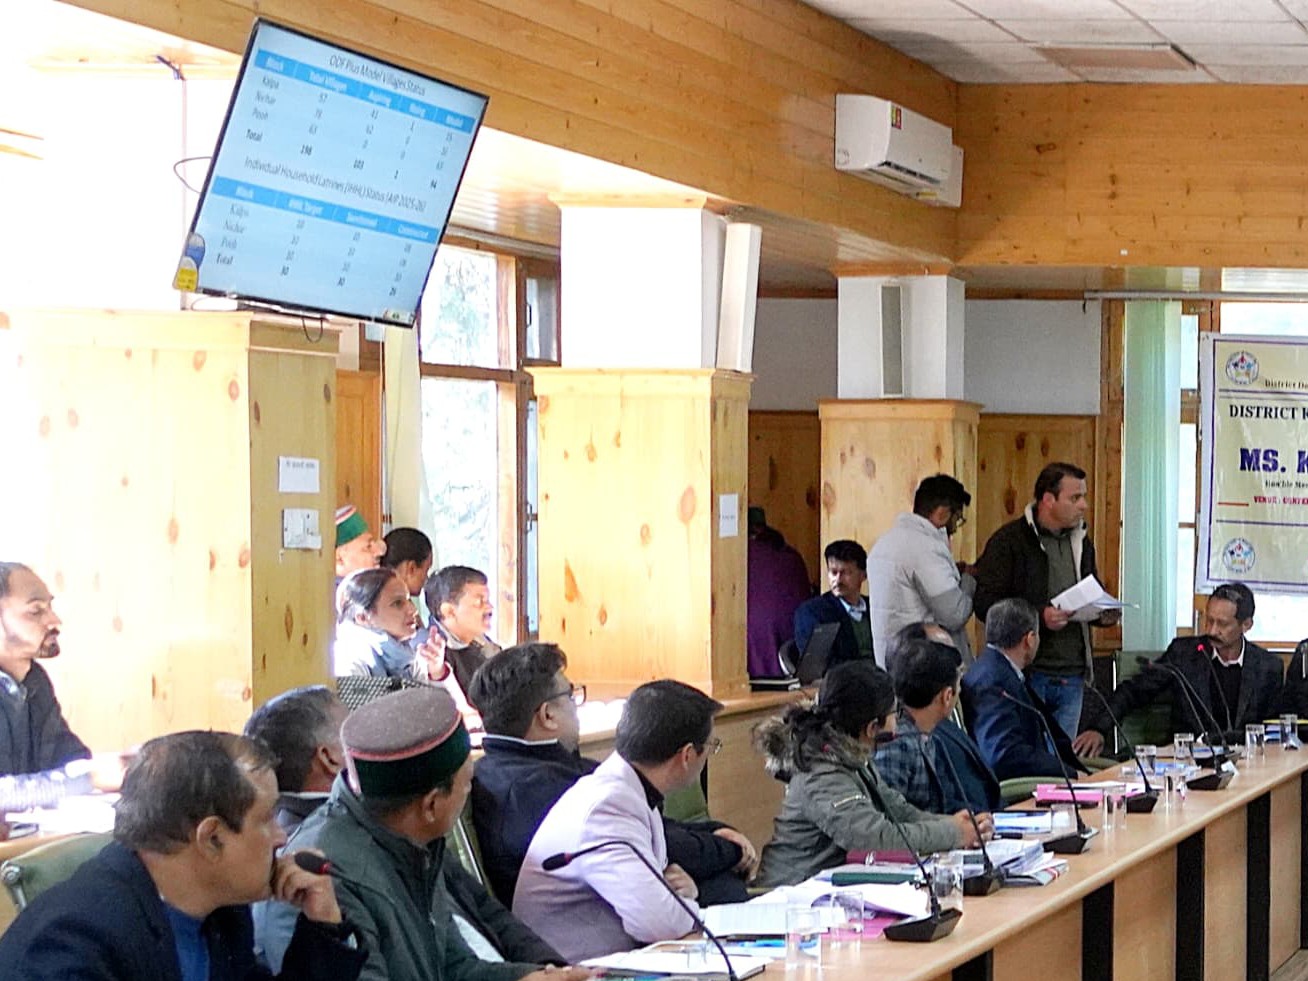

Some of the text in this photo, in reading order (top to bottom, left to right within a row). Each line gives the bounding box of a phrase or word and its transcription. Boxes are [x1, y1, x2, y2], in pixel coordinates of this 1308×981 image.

[346, 59, 360, 73] Plus
[361, 64, 382, 80] Model
[383, 72, 408, 91] Villages
[408, 81, 426, 94] Status
[246, 129, 262, 143] Total
[300, 143, 313, 155] 198
[245, 157, 280, 175] Individual
[281, 167, 317, 183] Household
[317, 176, 344, 191] Latrines
[366, 188, 386, 201] Status
[217, 254, 232, 265] Total
[1264, 379, 1296, 389] District
[1229, 404, 1298, 420] DISTRICT
[1239, 447, 1287, 474] MS.
